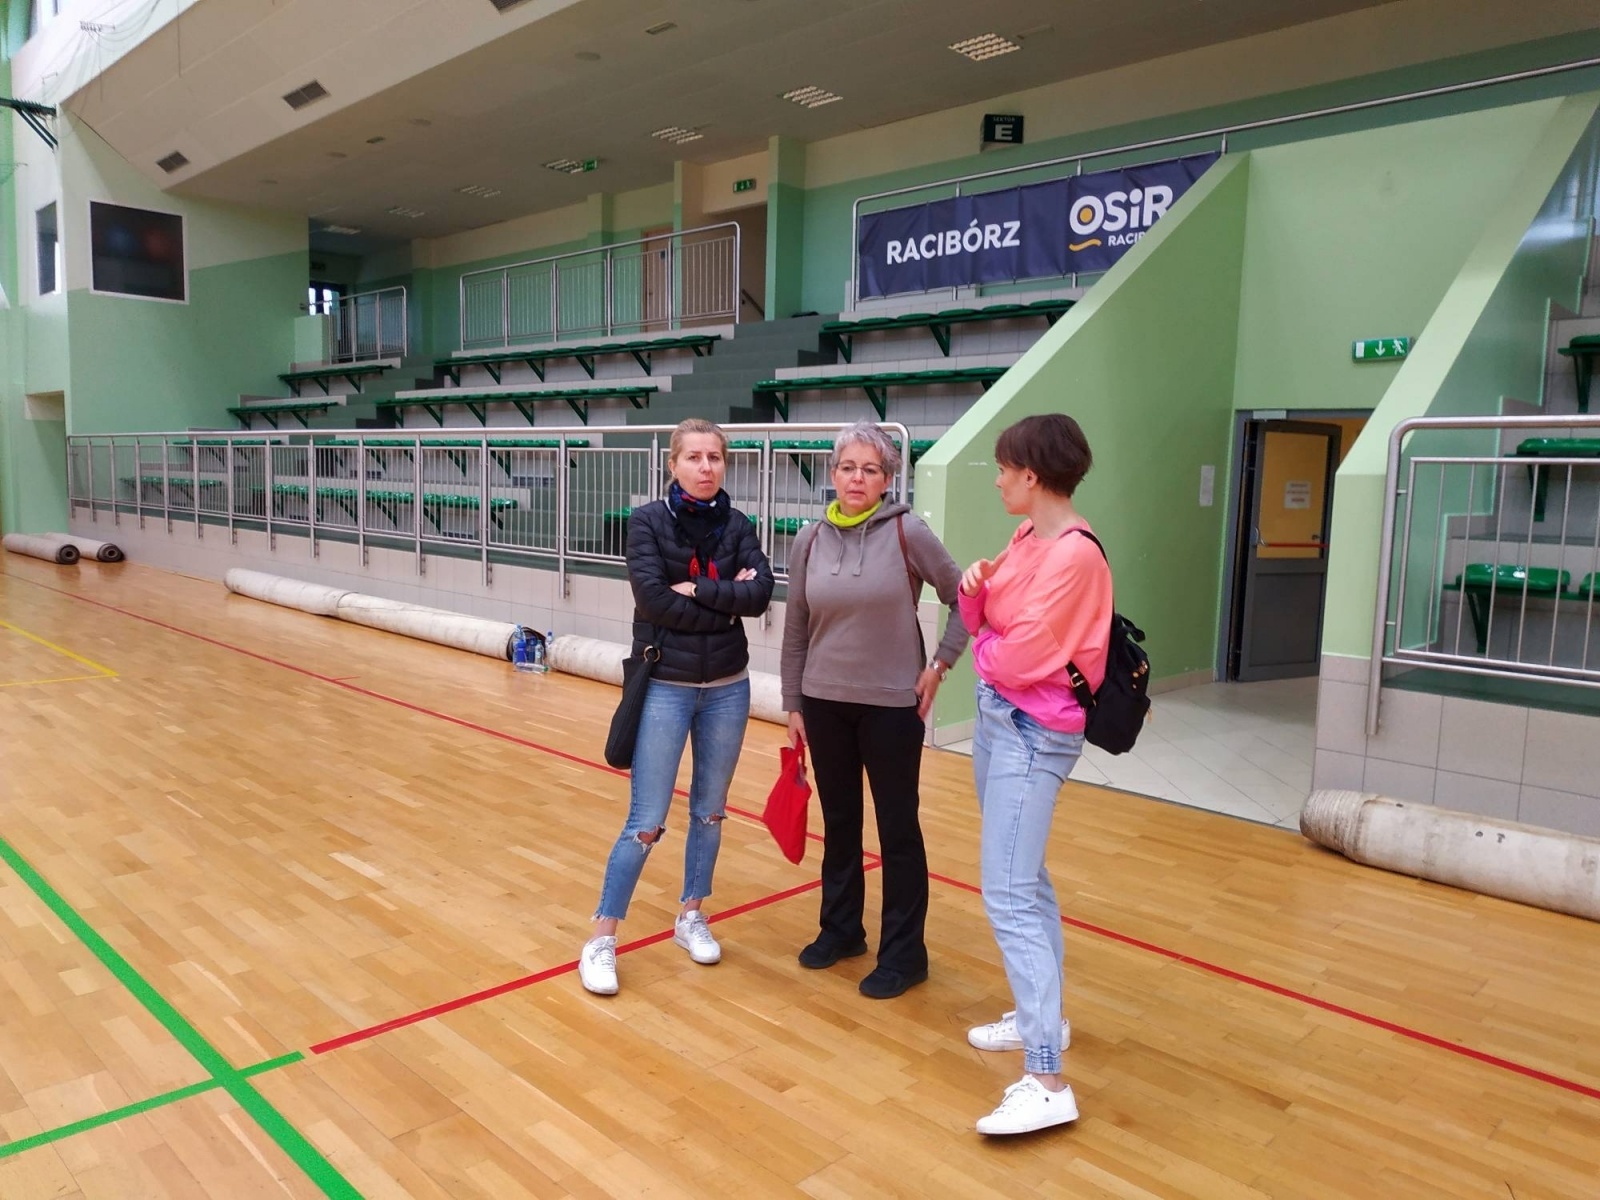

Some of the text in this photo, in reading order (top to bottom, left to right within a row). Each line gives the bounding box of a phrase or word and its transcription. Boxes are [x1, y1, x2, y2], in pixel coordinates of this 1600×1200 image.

[995, 124, 1013, 141] E
[1069, 185, 1173, 235] OSiR
[887, 218, 1021, 265] RACIBÓRZ
